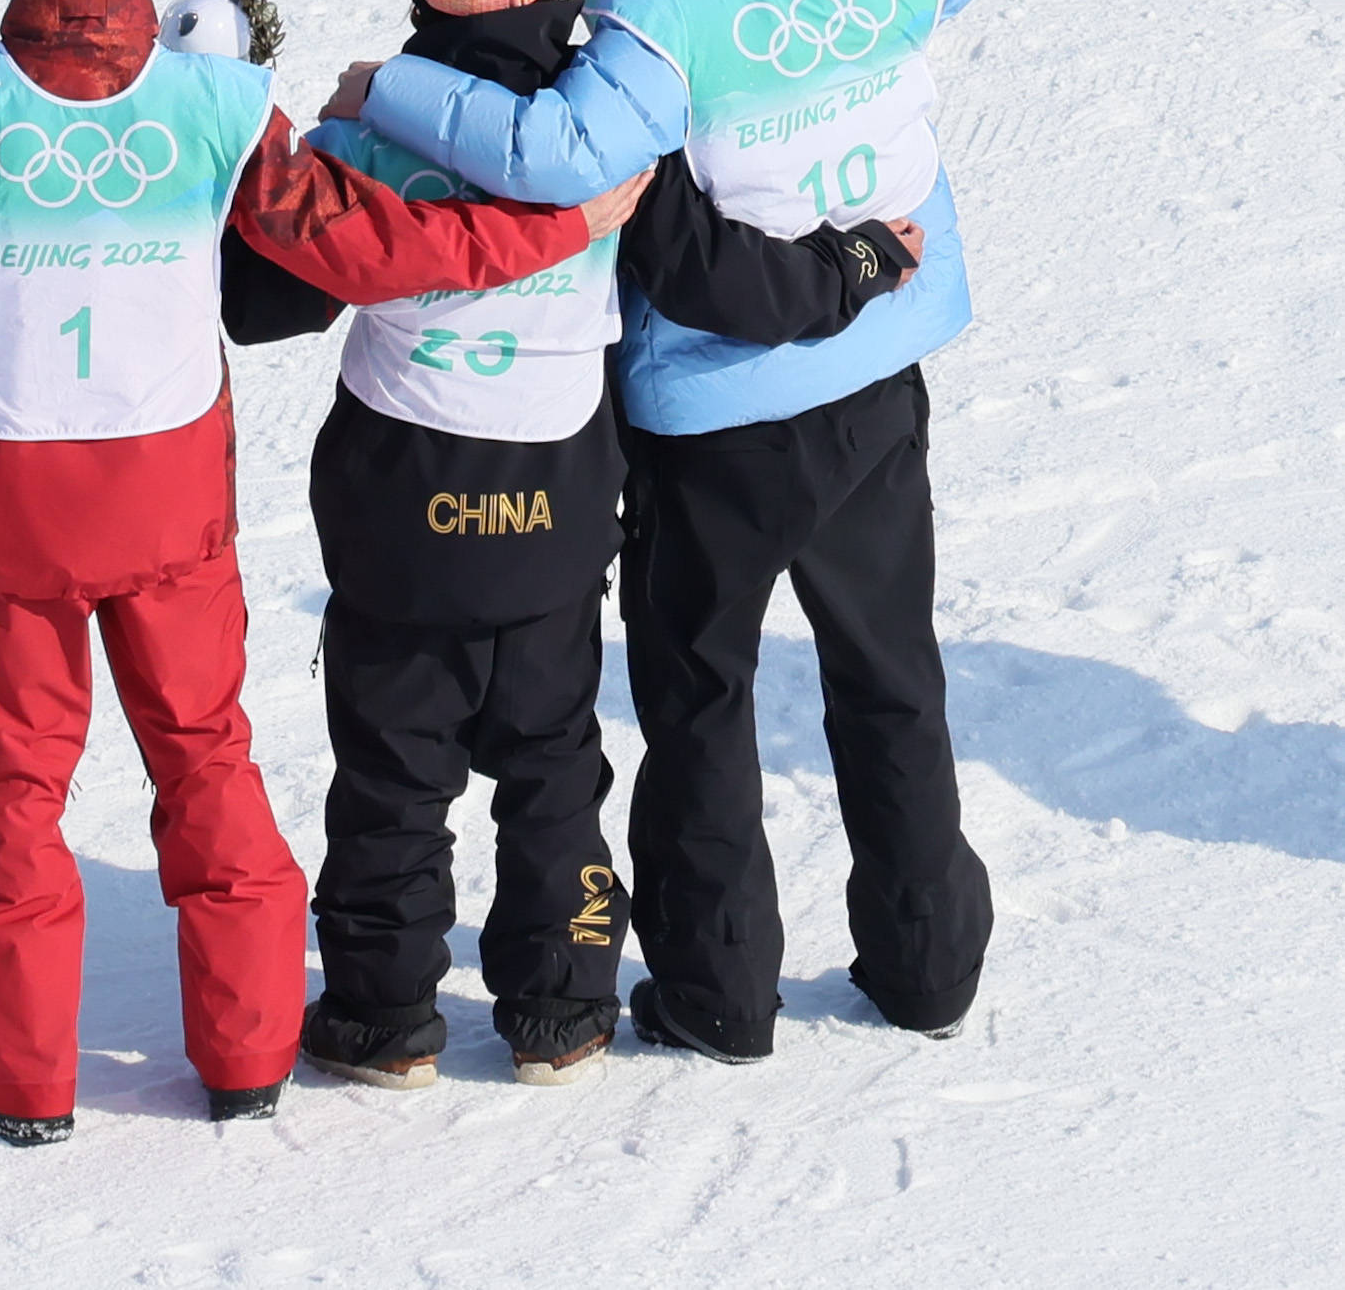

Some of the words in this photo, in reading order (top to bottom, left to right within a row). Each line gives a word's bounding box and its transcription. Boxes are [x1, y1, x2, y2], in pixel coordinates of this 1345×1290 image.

[737, 95, 837, 150] BEIJING
[844, 64, 902, 112] 2022
[797, 143, 878, 217] 10
[102, 241, 188, 267] 2022
[60, 306, 92, 380] 1
[409, 329, 518, 377] 23
[427, 490, 553, 535] CHINA
